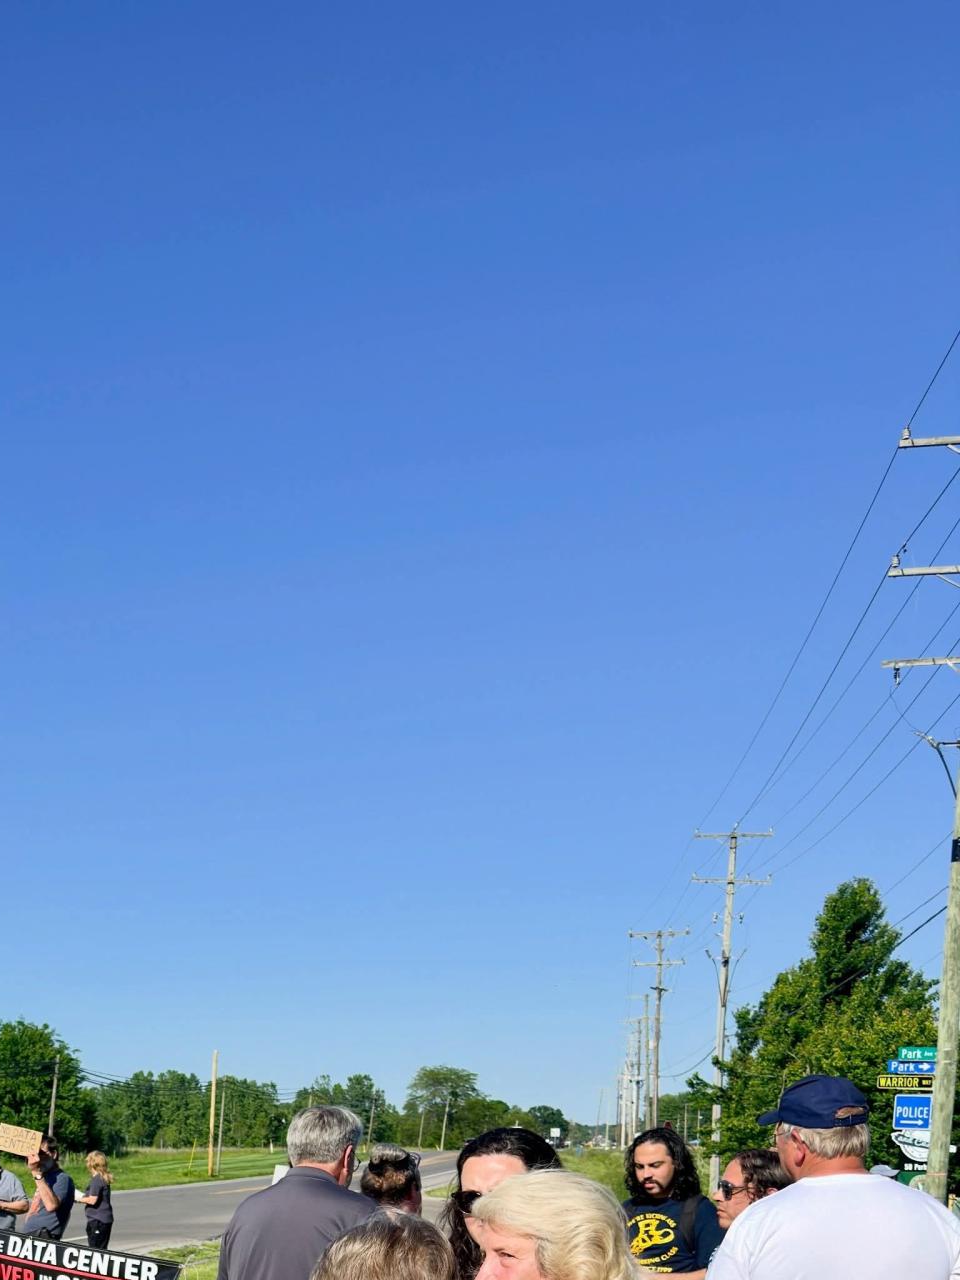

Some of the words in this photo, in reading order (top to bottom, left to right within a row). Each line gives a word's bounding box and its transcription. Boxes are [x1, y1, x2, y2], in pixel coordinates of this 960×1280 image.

[902, 1049, 922, 1058] Park
[891, 1062, 915, 1071] Park
[880, 1078, 919, 1087] WARRIOR
[896, 1106, 929, 1118] POLICE
[7, 1235, 57, 1266] DATA
[660, 1246, 678, 1261] CLASS
